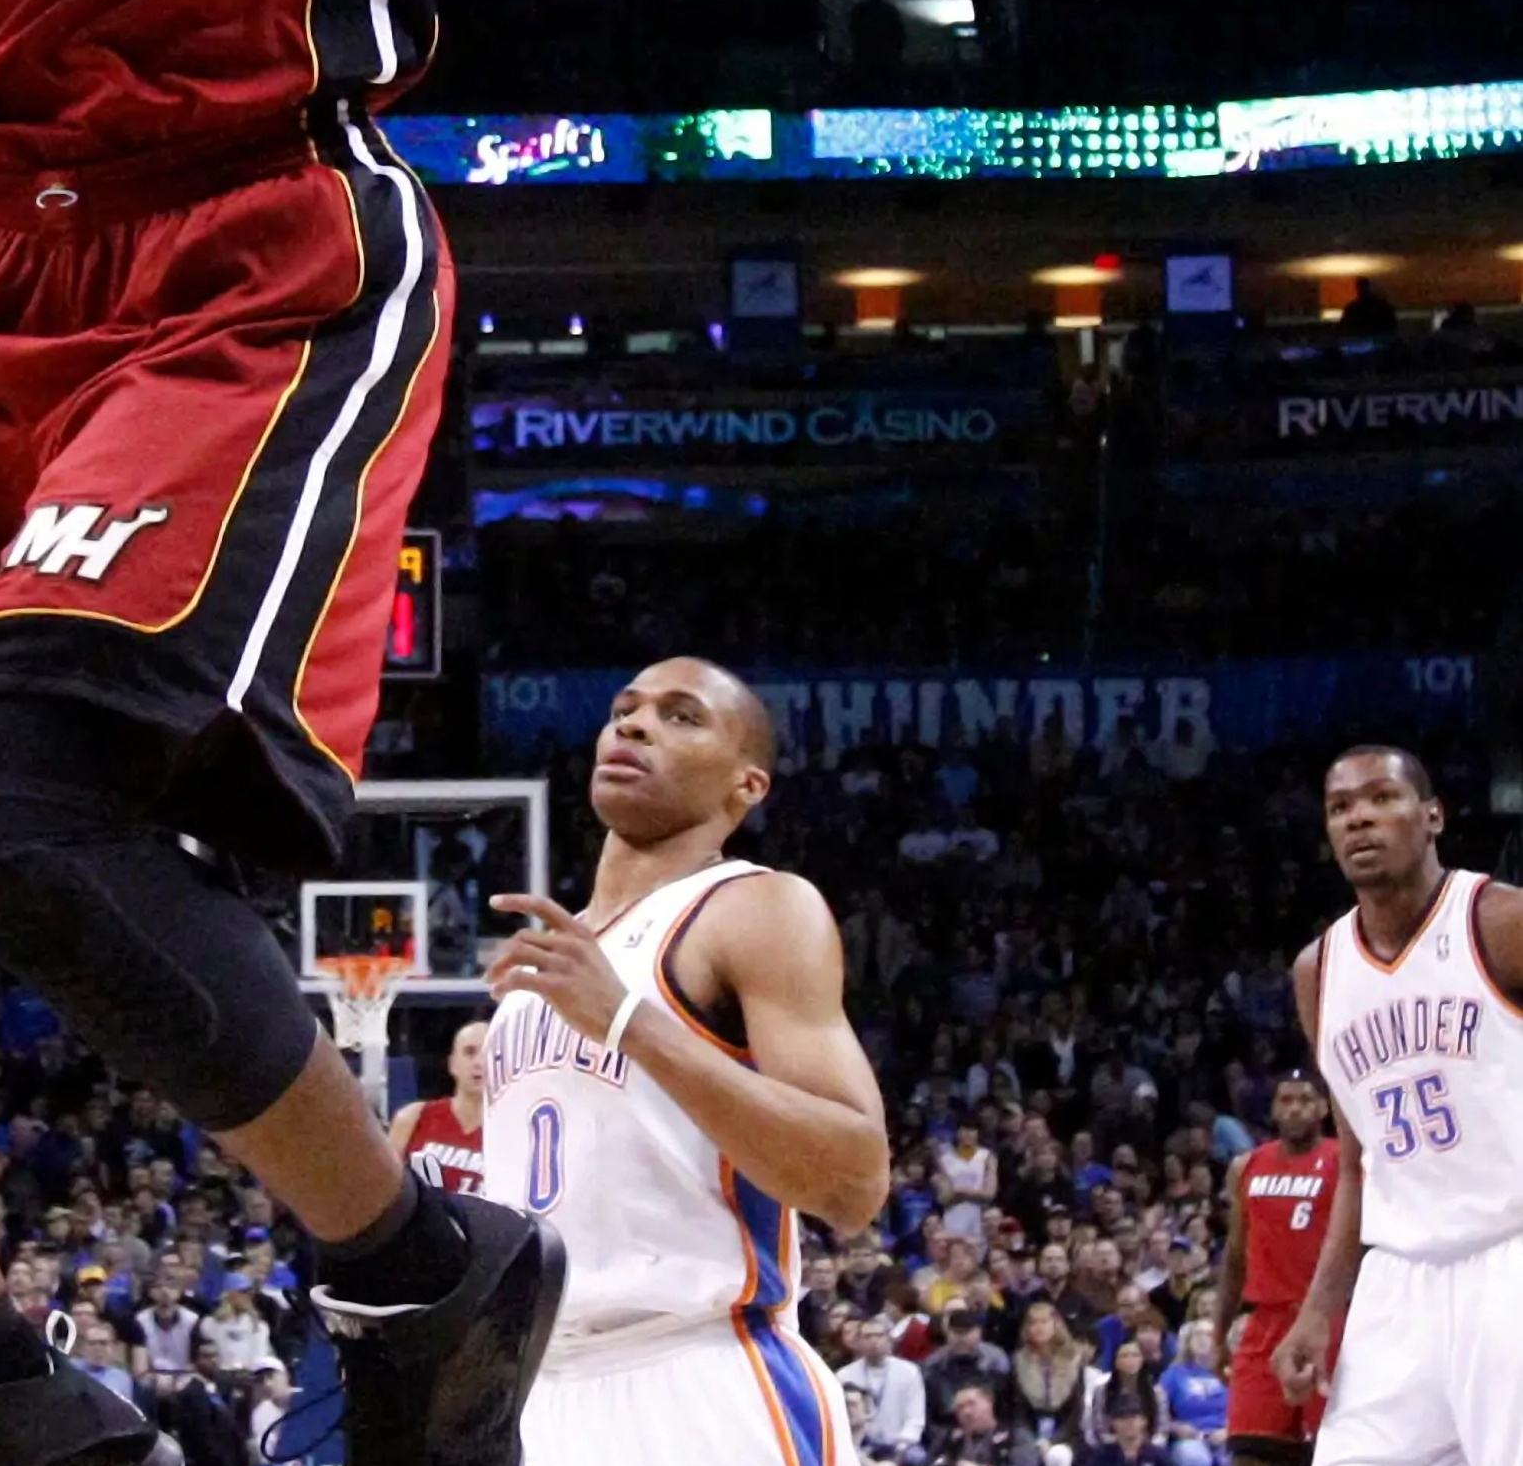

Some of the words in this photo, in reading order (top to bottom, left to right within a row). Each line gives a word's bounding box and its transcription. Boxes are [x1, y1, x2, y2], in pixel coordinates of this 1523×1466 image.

[513, 407, 796, 449] RIVERWIND
[805, 406, 998, 448] CASINO
[1404, 655, 1475, 694] 101
[1371, 1069, 1462, 1164] 35
[527, 1099, 564, 1216] 0
[1248, 1173, 1323, 1198] MIAMI
[1290, 1200, 1313, 1230] 6
